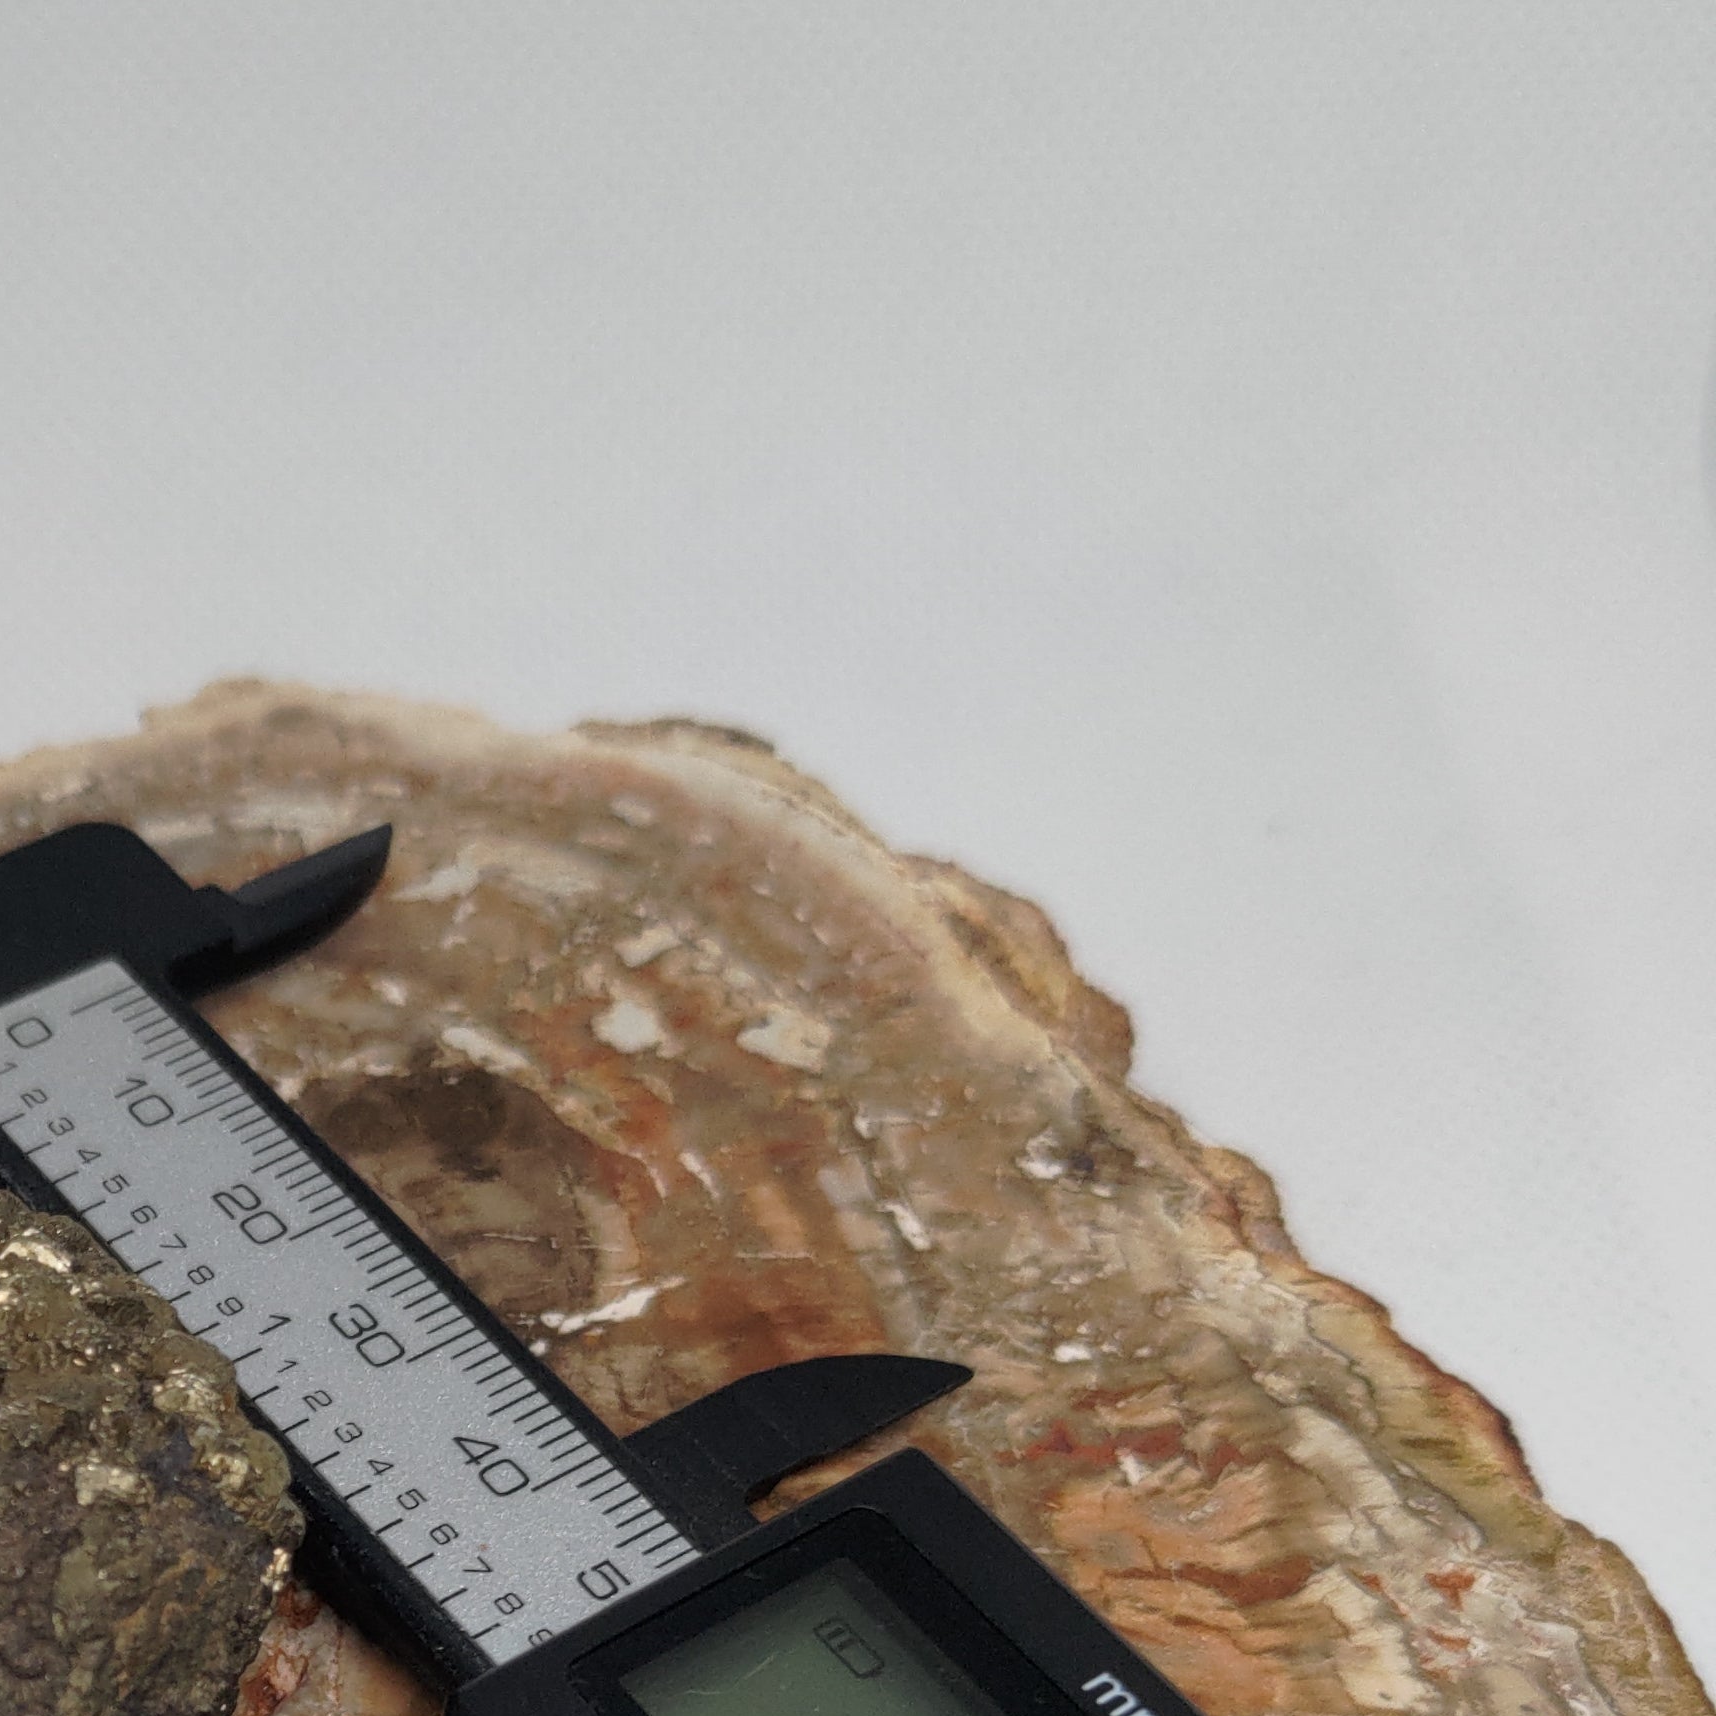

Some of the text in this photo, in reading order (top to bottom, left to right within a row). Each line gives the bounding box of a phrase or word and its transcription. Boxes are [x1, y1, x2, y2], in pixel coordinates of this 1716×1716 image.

[6, 1016, 53, 1049] 0
[114, 1076, 174, 1127] 10
[212, 1184, 288, 1244] 20
[328, 1303, 405, 1368] 30
[453, 1435, 529, 1497] 40
[20, 1089, 48, 1109] 2
[47, 1117, 75, 1136] 3
[77, 1148, 102, 1164] 4
[102, 1174, 130, 1195] 5
[130, 1205, 158, 1225] 6
[159, 1233, 187, 1251] 7
[187, 1265, 215, 1286] 8
[216, 1296, 244, 1317] 9
[303, 1390, 333, 1412] 2
[334, 1422, 363, 1444] 3
[367, 1458, 395, 1475] 4
[397, 1488, 427, 1511] 5
[429, 1523, 459, 1545] 6
[463, 1558, 492, 1577] 7
[494, 1592, 524, 1615] 8
